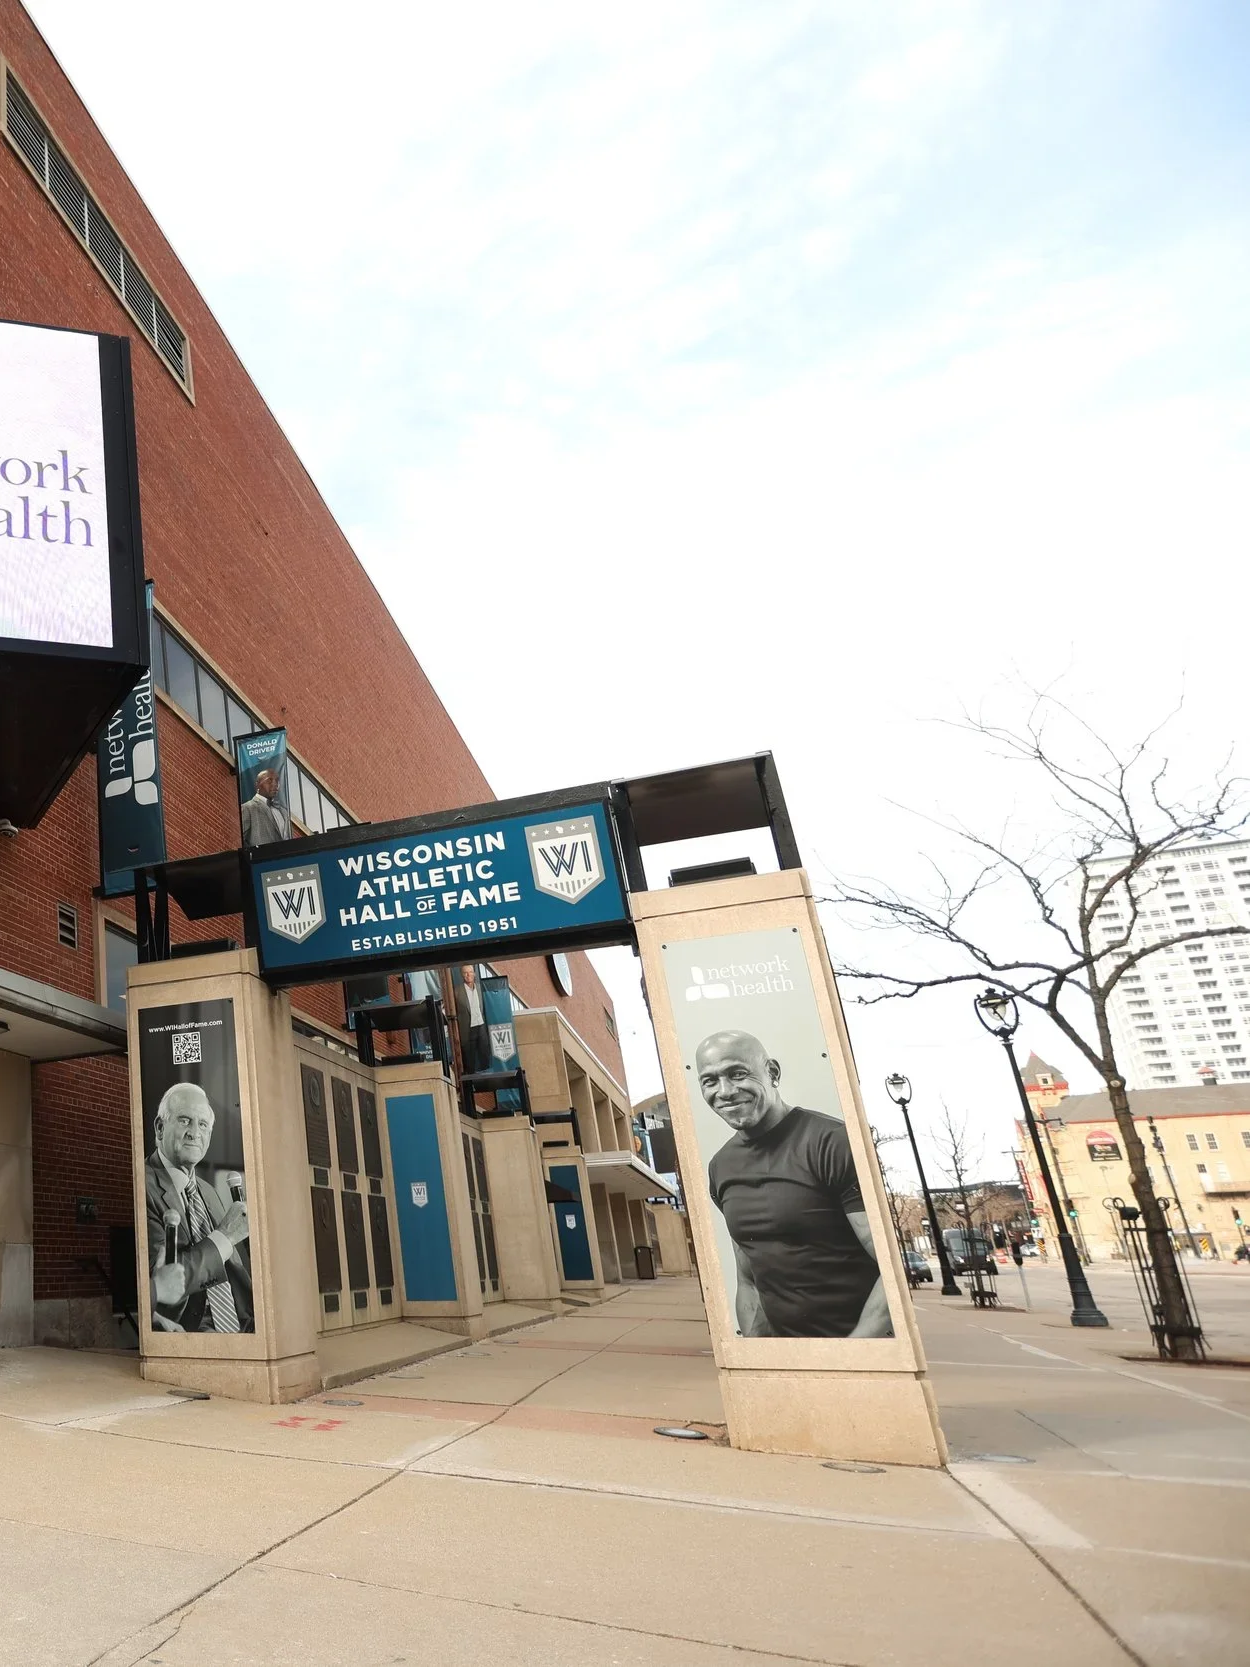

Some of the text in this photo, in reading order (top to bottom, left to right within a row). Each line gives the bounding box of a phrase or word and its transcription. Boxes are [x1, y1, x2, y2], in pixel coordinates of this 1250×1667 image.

[246, 738, 277, 750] DONALD
[248, 745, 276, 756] DRIVER
[337, 831, 506, 877] WISCONSIN
[538, 839, 593, 878] WI
[356, 860, 495, 900] ATHLETIC
[271, 885, 317, 920] WI
[339, 881, 521, 927] HALL OF FAME
[351, 916, 518, 951] ESTABLISHED 1951
[706, 954, 791, 981] network
[730, 974, 795, 997] health
